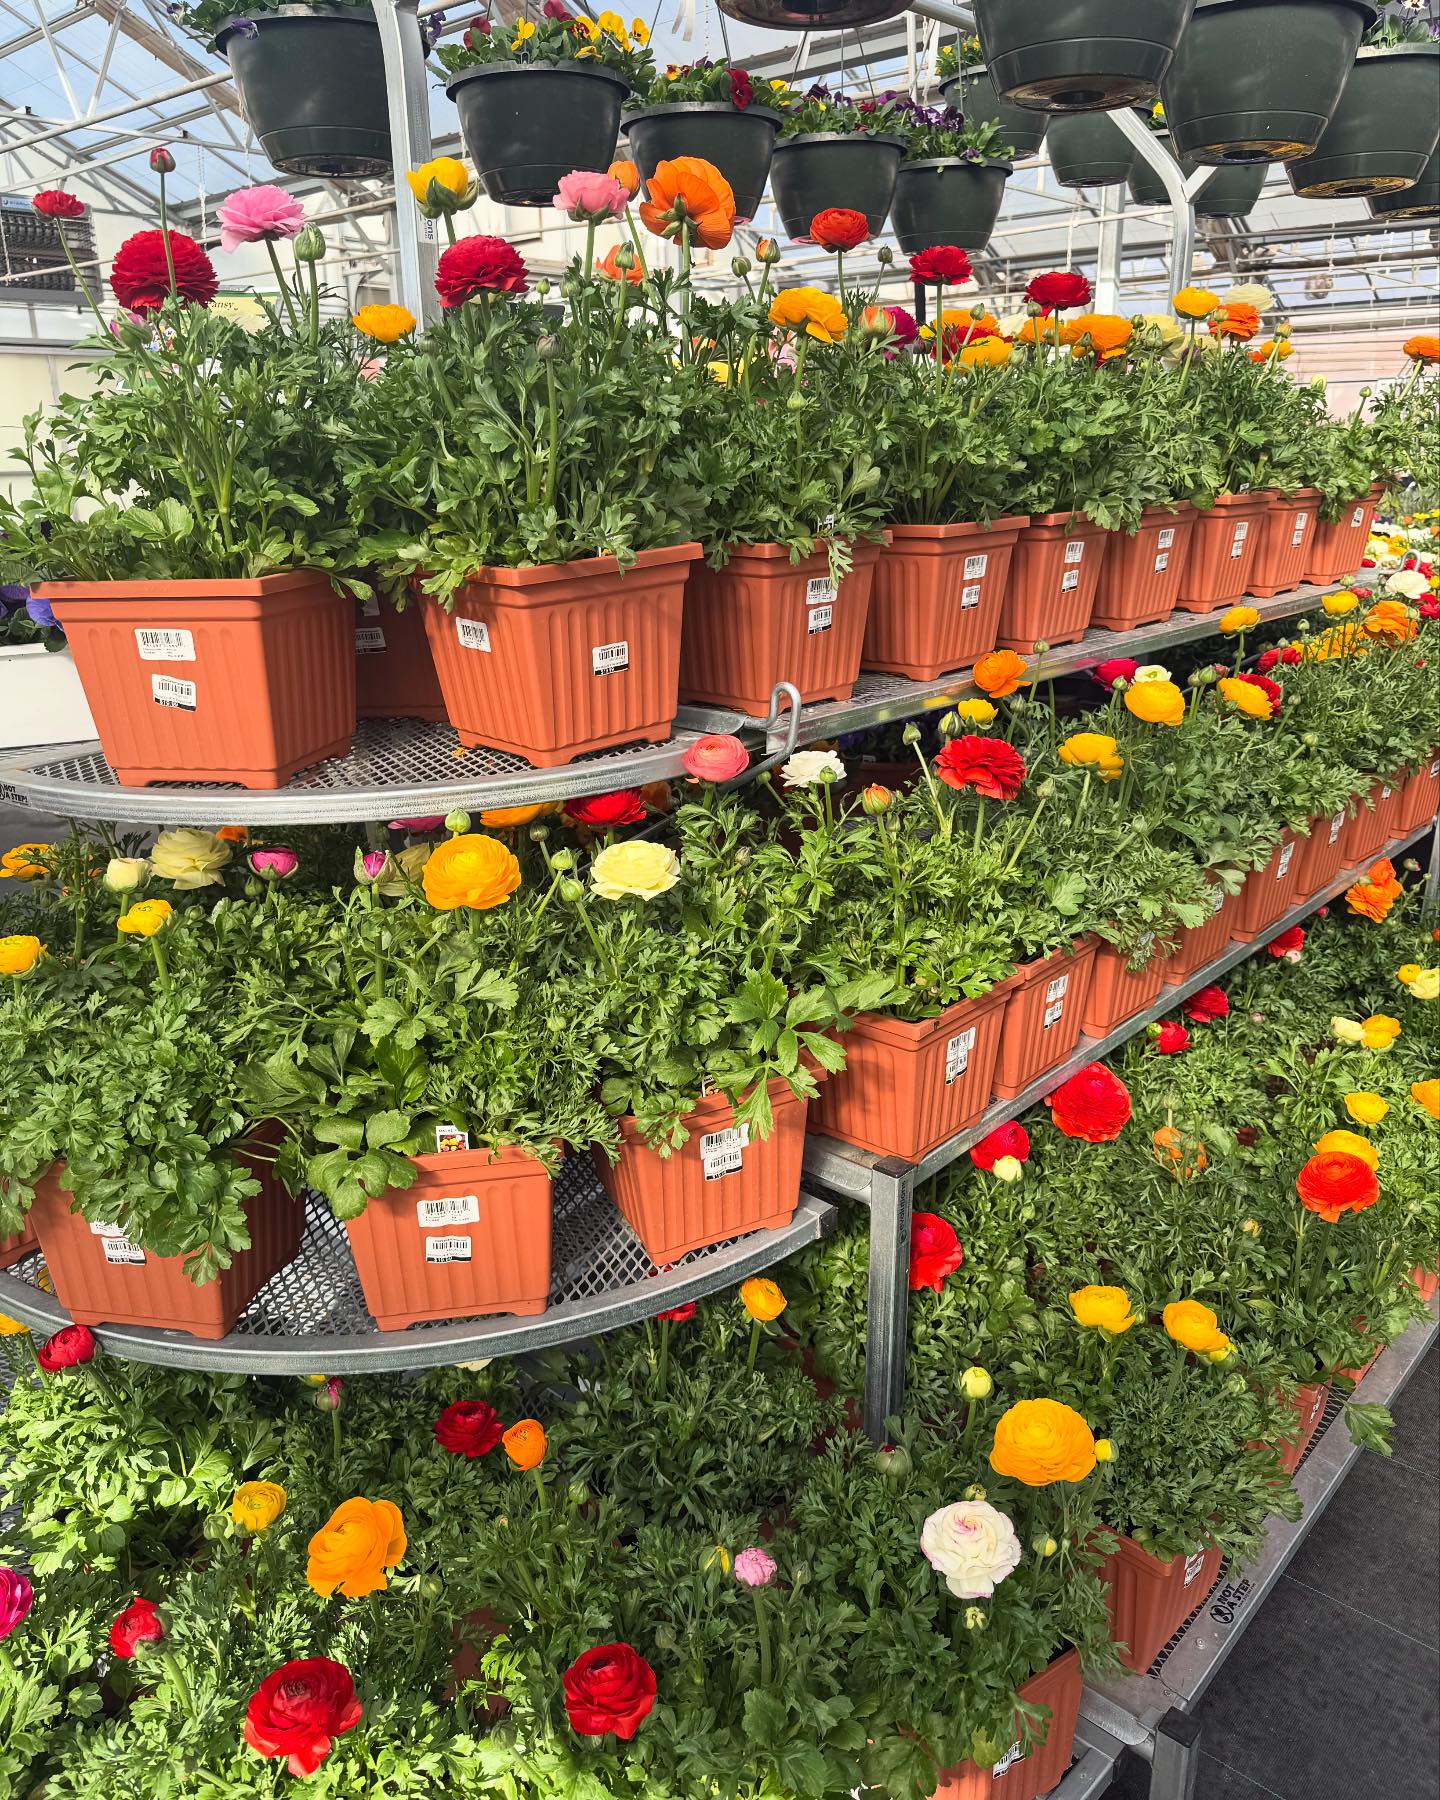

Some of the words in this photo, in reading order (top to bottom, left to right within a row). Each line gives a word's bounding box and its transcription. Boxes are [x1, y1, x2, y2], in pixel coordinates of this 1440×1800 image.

[1217, 1583, 1235, 1605] NOT
[1227, 1601, 1237, 1610] A
[1232, 1579, 1250, 1600] STEP
